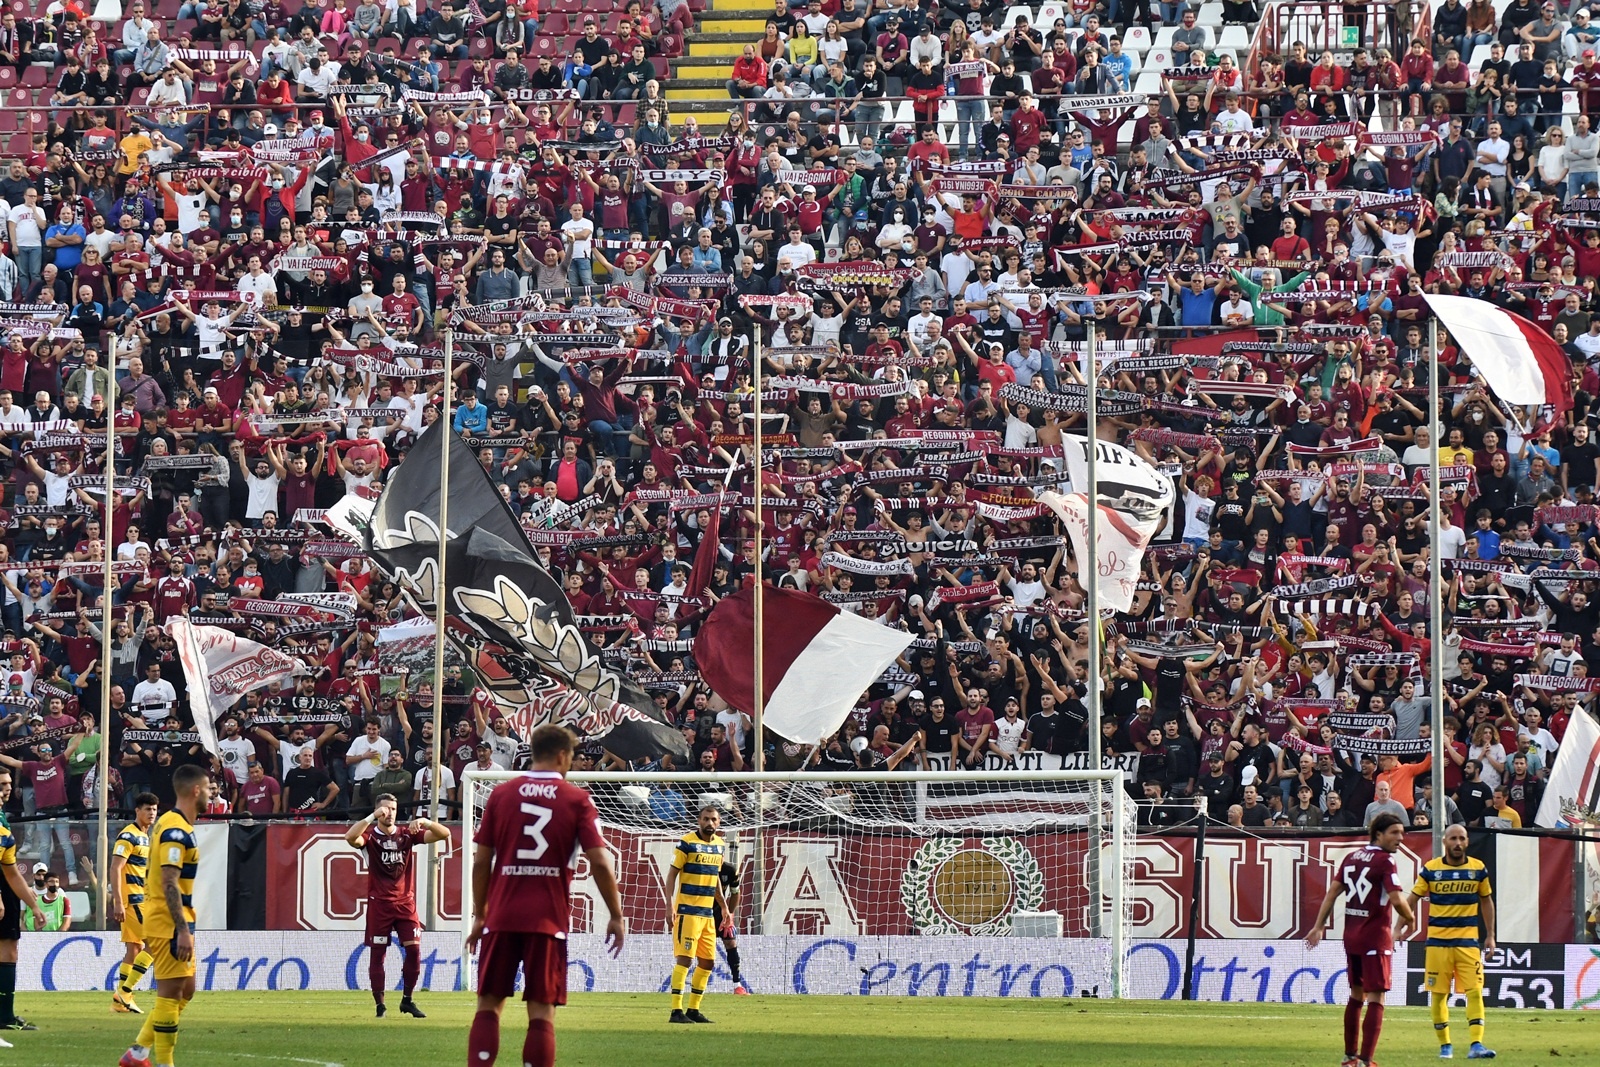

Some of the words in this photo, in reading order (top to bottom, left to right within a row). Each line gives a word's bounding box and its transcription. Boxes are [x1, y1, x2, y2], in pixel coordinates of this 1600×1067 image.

[1299, 126, 1312, 137] VAI
[1314, 125, 1351, 137] REGGINA
[268, 139, 284, 150] VAI
[285, 137, 317, 149] REGGINA
[1371, 133, 1404, 144] REGGINA
[1405, 132, 1423, 143] 1914
[784, 172, 796, 184] VAI
[797, 171, 832, 185] REGGINA
[939, 180, 953, 192] 1914
[957, 179, 985, 192] REGGINA
[1001, 189, 1025, 199] GGIO
[287, 260, 299, 269] VAI
[300, 260, 338, 270] REGGINA
[808, 266, 832, 276] Reggina
[834, 265, 857, 274] Calcio
[858, 264, 873, 272] 1914
[661, 276, 687, 284] FORZA
[689, 276, 725, 285] REGGINA
[1272, 290, 1341, 302] AMARANTO
[18, 303, 53, 312] REGGINA
[658, 302, 675, 313] 1914
[502, 312, 518, 323] 1914
[1119, 359, 1148, 370] FORZA
[1150, 357, 1184, 367] REGGINA
[361, 410, 399, 418] REGGINA
[1097, 404, 1119, 413] FORZA
[760, 434, 790, 444] ALABRIA
[922, 430, 958, 440] REGGINA
[958, 430, 976, 440] 1914
[924, 453, 948, 462] FORZA
[950, 450, 983, 460] REGGINA
[870, 467, 924, 480] REGGINA
[1346, 464, 1376, 472] SALMMU
[1421, 467, 1452, 478] REGINA
[976, 473, 1028, 485] CURVA
[1049, 471, 1069, 482] SU
[636, 489, 671, 500] REGGINA
[671, 489, 689, 498] 1914
[985, 507, 997, 517] VAI
[998, 507, 1037, 519] REGGINA
[526, 532, 554, 543] EGGINA
[556, 532, 573, 544] 1914
[988, 538, 1030, 549] URVA
[1292, 555, 1315, 564] REGGINA
[1317, 556, 1338, 566] 1914
[1452, 559, 1508, 572] REGGINA
[1273, 583, 1309, 597] URVA
[1329, 575, 1357, 590] SUD
[244, 602, 277, 613] REGGINA
[278, 604, 300, 615] 1914
[191, 616, 246, 625] REGGINA
[954, 641, 981, 652] SUD
[211, 661, 259, 691] CURVA
[882, 673, 918, 684] SUD
[1529, 675, 1543, 685] VAI
[1544, 676, 1586, 688] REGGINA
[226, 674, 255, 694] Reggio
[1353, 717, 1388, 727] REGGINA
[181, 732, 205, 742] SU
[1349, 739, 1378, 750] FORZA
[1381, 741, 1422, 751] REGGINA
[1059, 756, 1135, 773] LIERI
[519, 784, 557, 799] CIONEK
[518, 803, 552, 860] 3
[694, 854, 722, 865] Cetila
[297, 832, 867, 937] CRVA
[1344, 866, 1373, 905] 56
[1434, 880, 1477, 894] Cetilar
[40, 935, 310, 992] Ctro
[792, 938, 1075, 998] Centro
